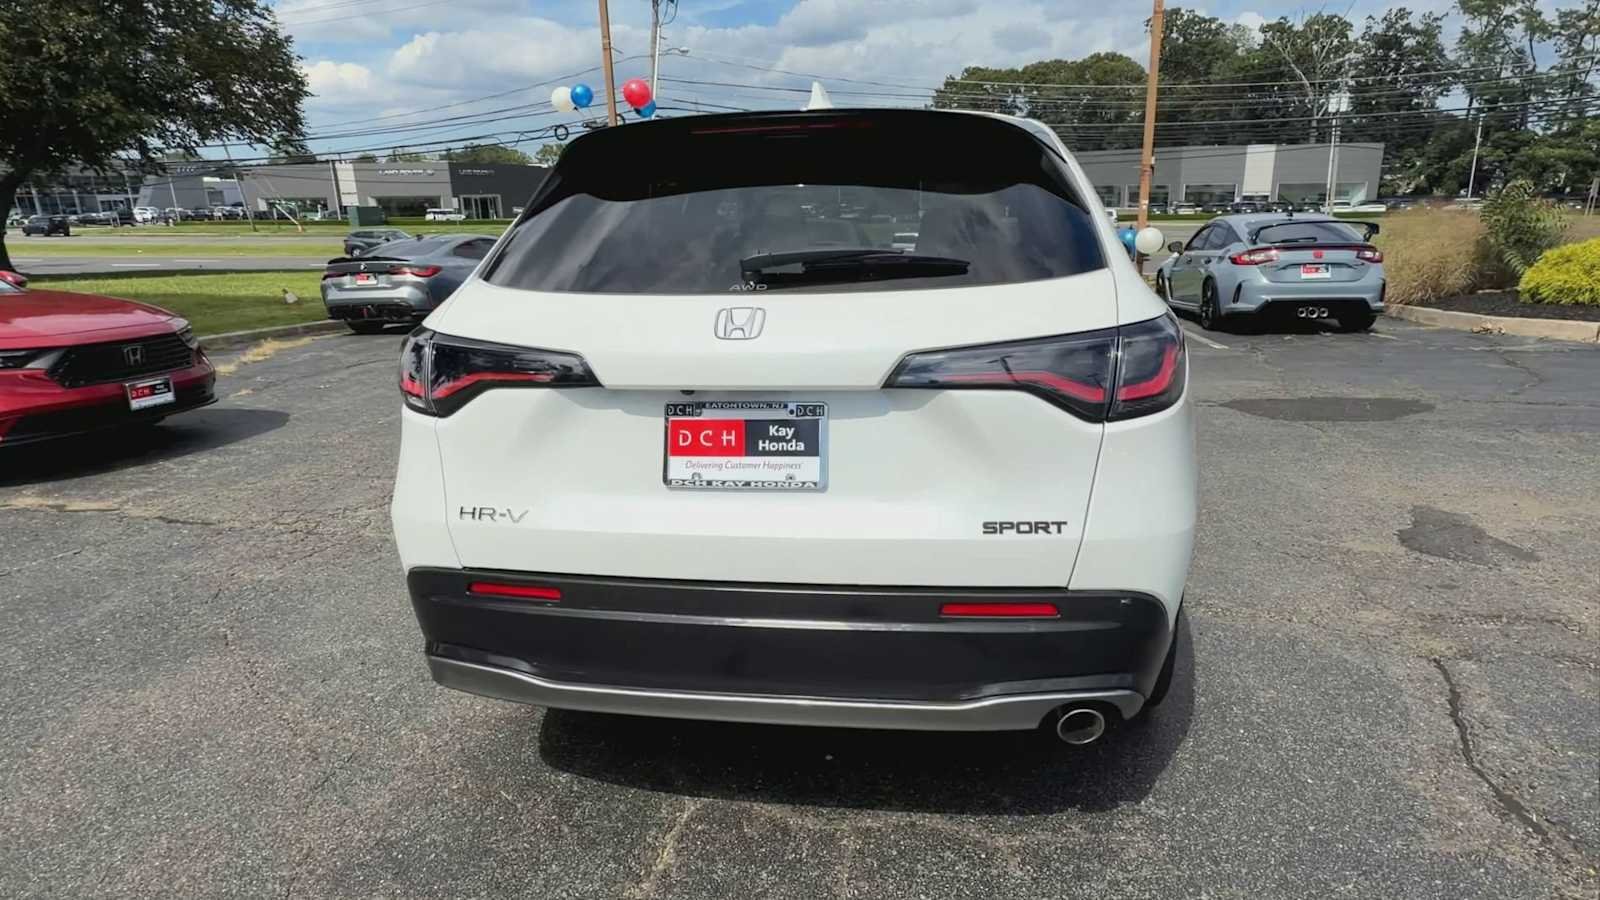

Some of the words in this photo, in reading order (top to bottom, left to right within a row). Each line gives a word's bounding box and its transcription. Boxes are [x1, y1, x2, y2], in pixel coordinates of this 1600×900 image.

[729, 283, 768, 291] AWD
[667, 405, 694, 416] DCH
[704, 401, 769, 410] EATONTOWN,
[774, 402, 785, 410] NJ
[797, 405, 824, 416] DCH
[678, 430, 736, 447] DCH
[769, 425, 796, 440] Kay
[758, 439, 805, 452] Honda
[685, 460, 723, 472] Delivering
[724, 460, 762, 471] Customer
[671, 479, 709, 488] DCH
[711, 480, 746, 488] KAY
[750, 480, 817, 489] HONDA
[459, 506, 529, 523] HR-V
[982, 521, 1068, 535] SPORT
